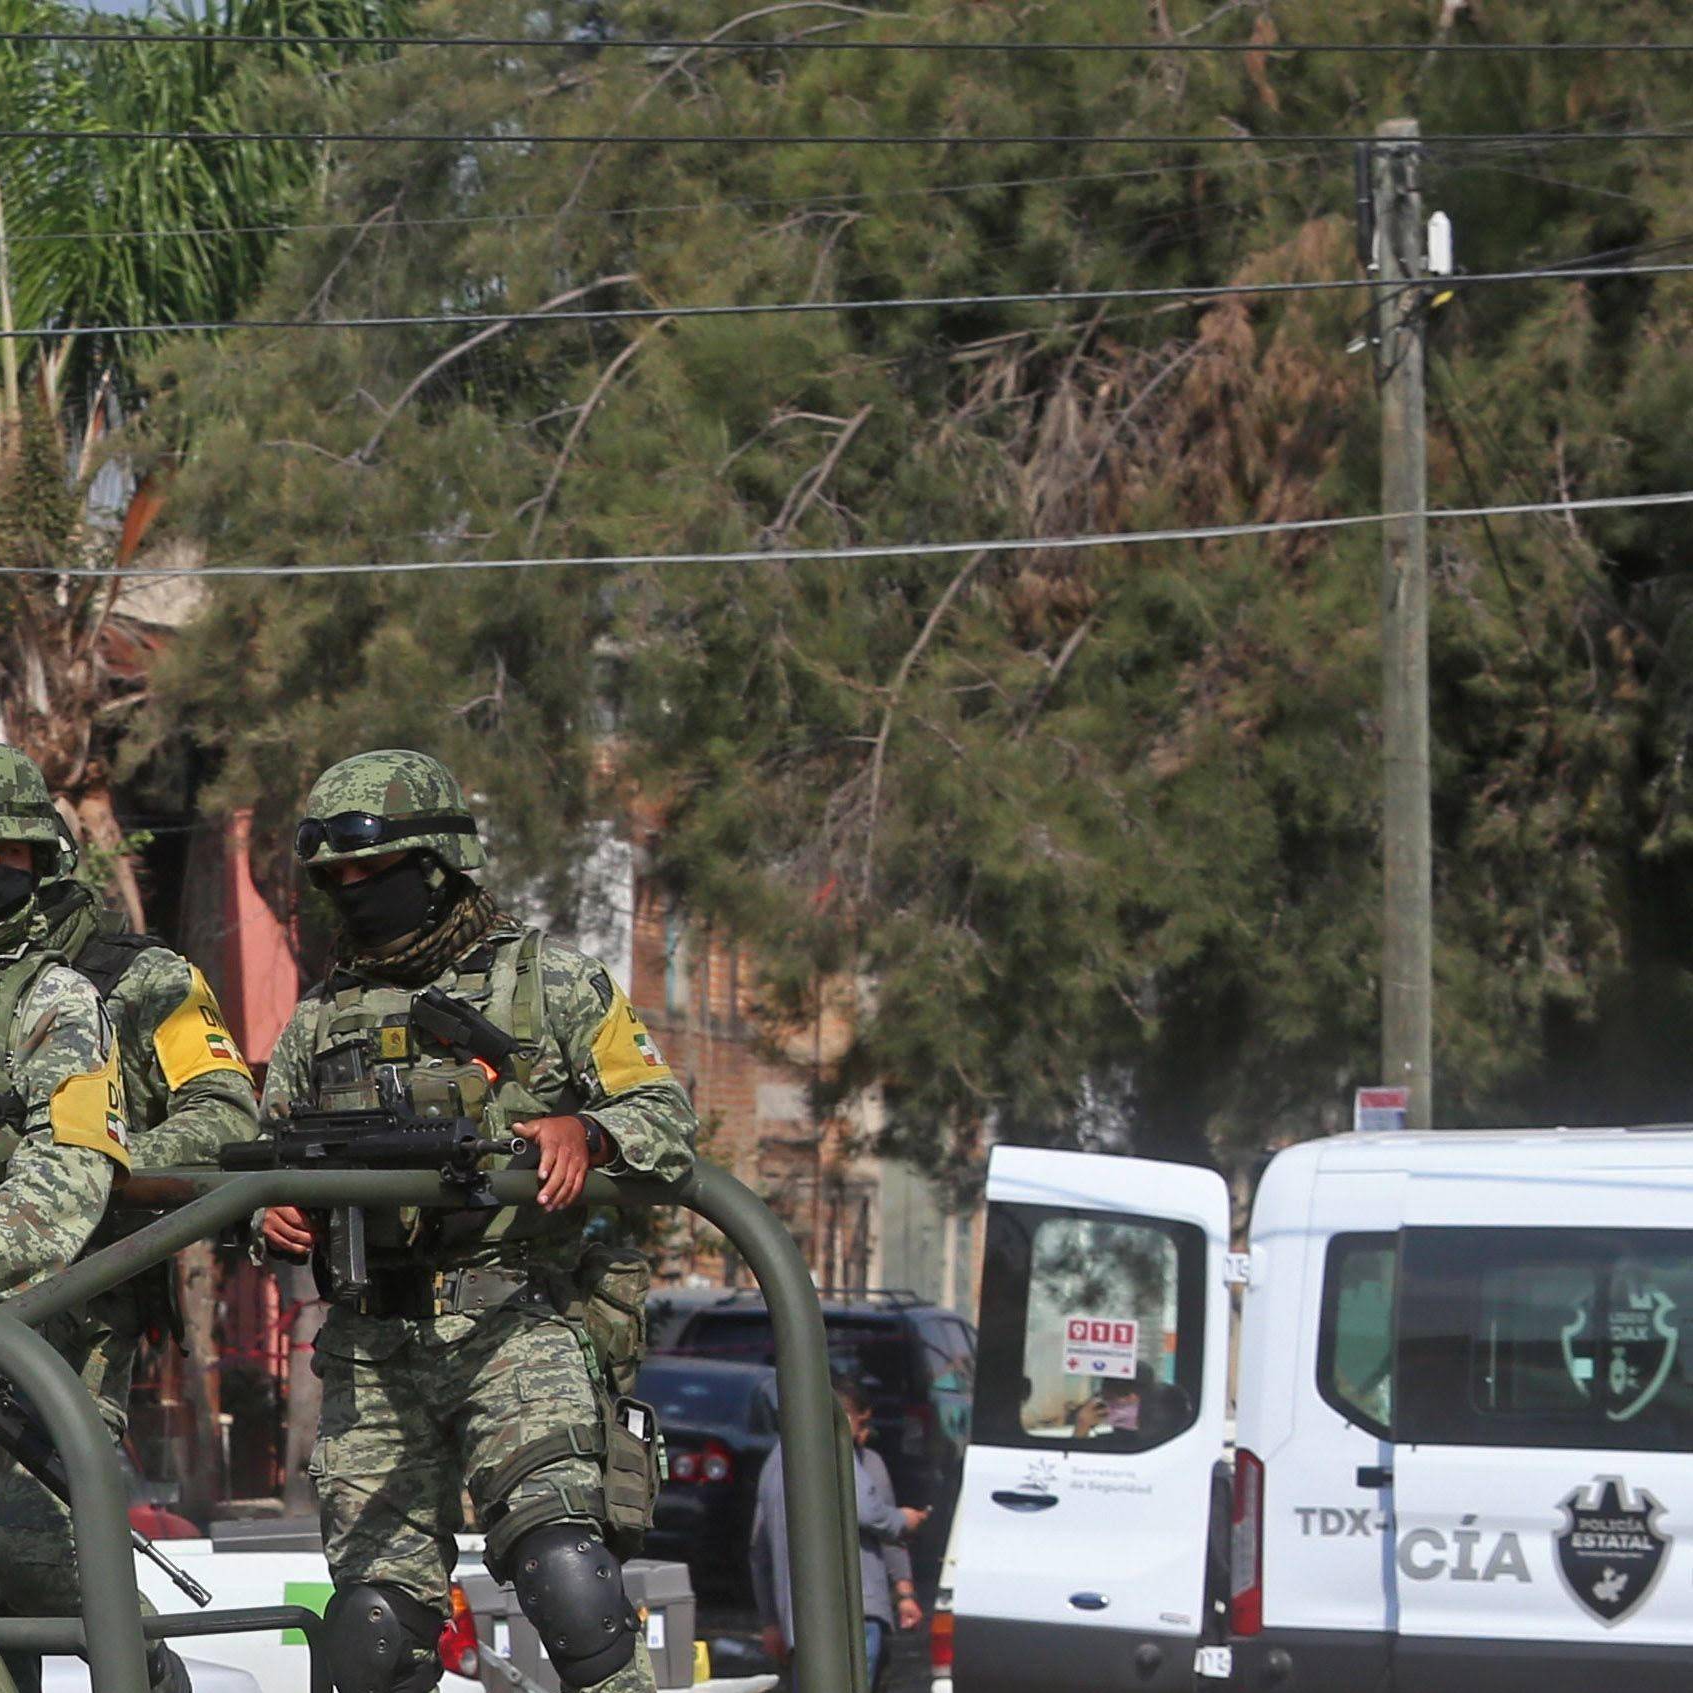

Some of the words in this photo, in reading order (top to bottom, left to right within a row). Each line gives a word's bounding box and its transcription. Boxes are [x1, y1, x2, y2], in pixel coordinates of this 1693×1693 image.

[1069, 1320, 1133, 1344] 911
[1397, 1513, 1534, 1584] CÍA
[1571, 1532, 1655, 1551] ESTATAL
